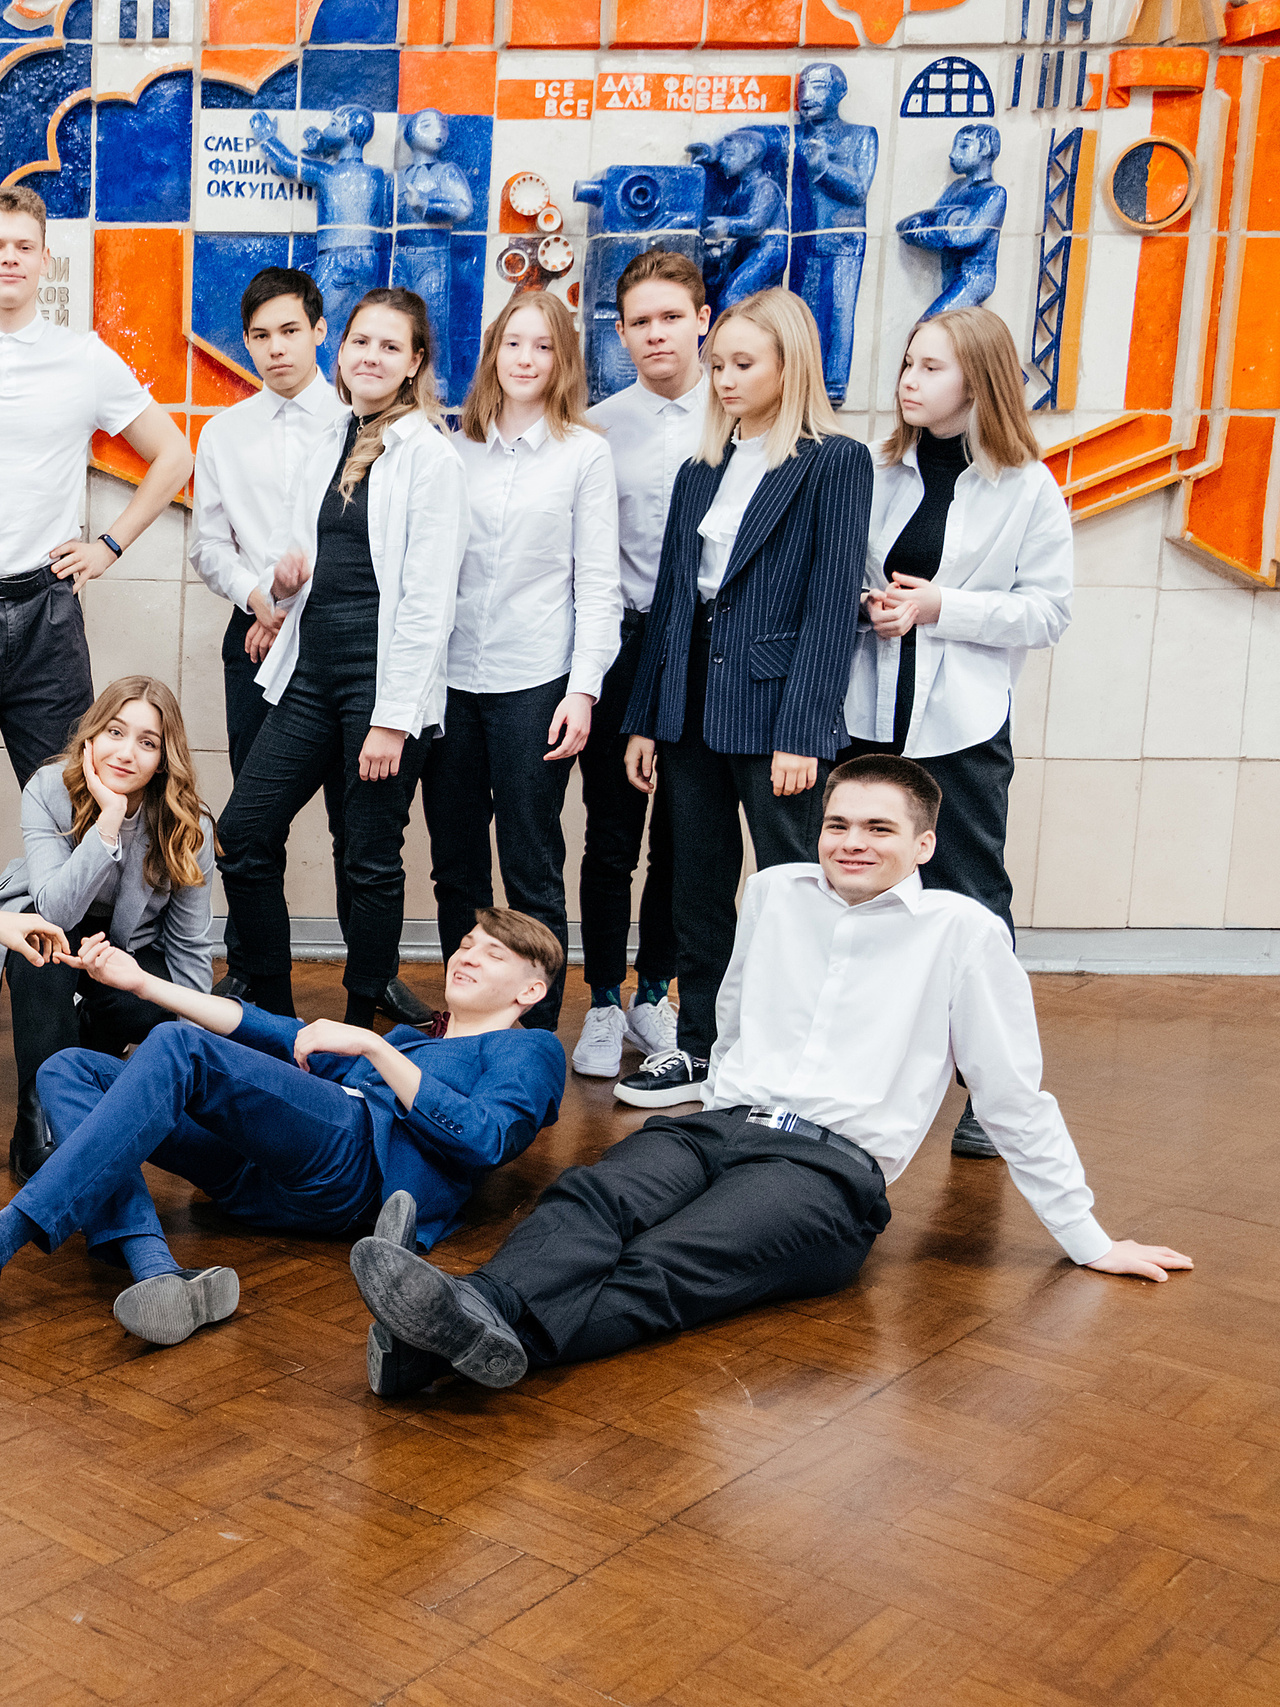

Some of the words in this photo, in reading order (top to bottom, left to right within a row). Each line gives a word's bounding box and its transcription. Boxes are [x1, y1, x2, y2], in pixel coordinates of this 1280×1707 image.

[535, 81, 575, 98] ВСЕ
[601, 75, 645, 92] ДЛЯ
[663, 76, 760, 94] ФРОНТА
[544, 98, 589, 117] ВСЕ
[606, 91, 651, 108] ДЛЯ
[666, 92, 767, 111] ПОБЕДЫ
[204, 136, 258, 152] СМЕР
[207, 180, 317, 200] ОККУПАНТ
